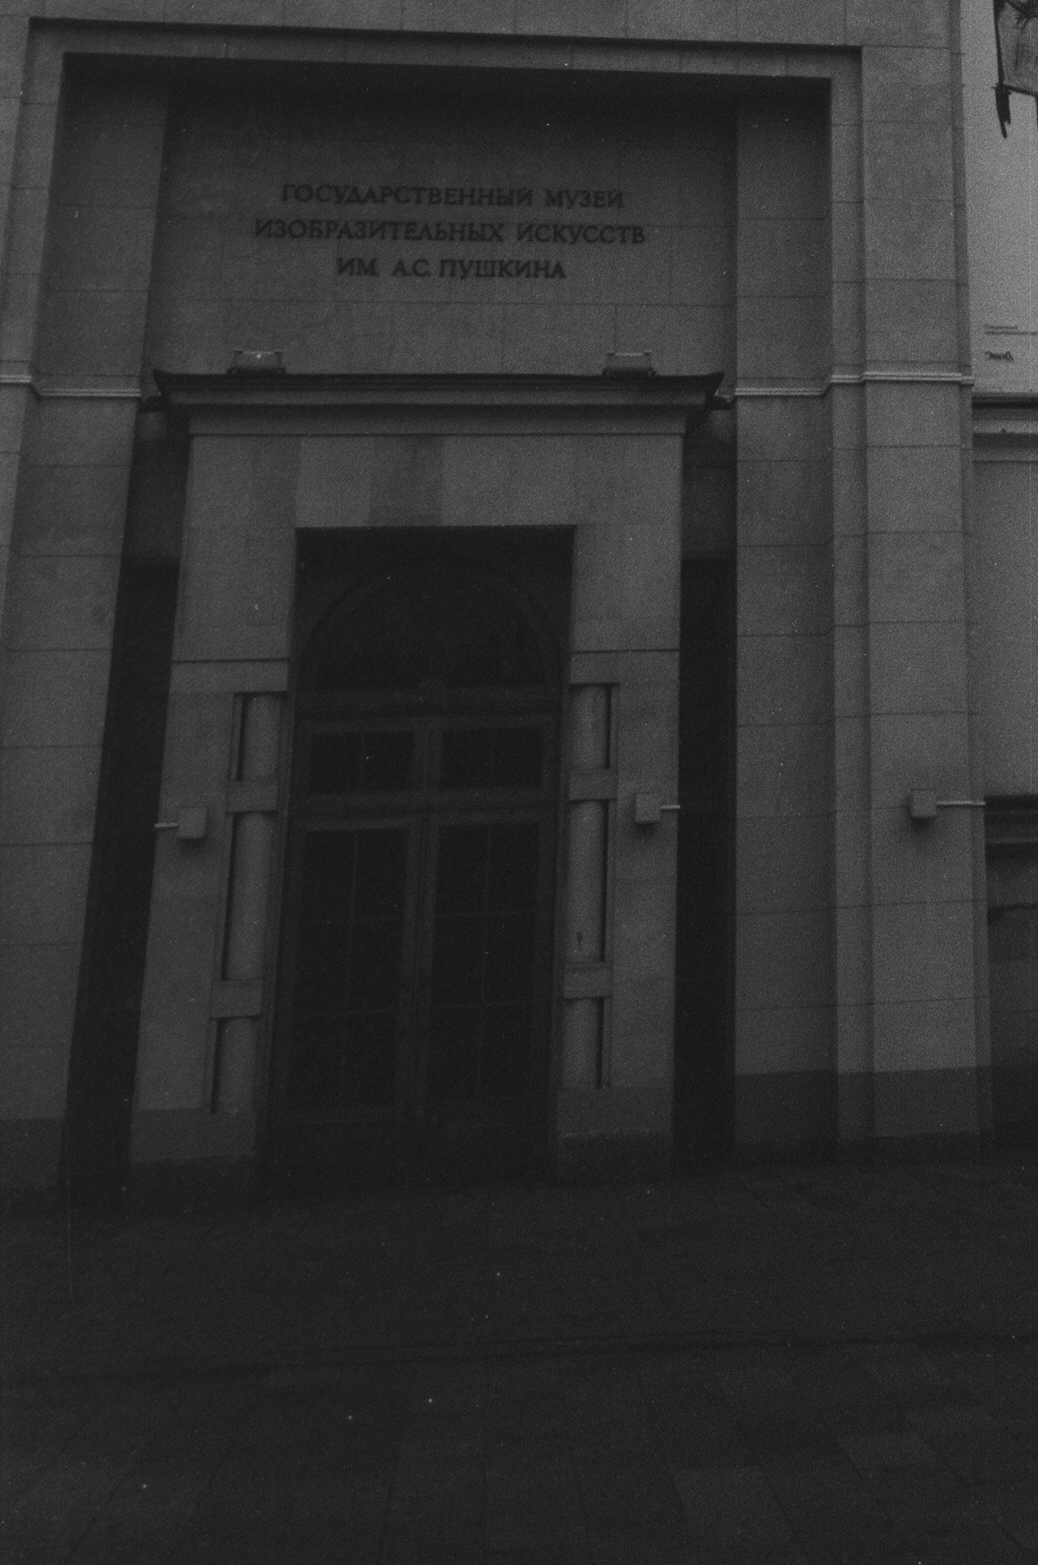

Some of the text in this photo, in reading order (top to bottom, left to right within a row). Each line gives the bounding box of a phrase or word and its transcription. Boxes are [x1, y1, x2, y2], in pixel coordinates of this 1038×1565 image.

[281, 183, 624, 210] ГОСУДАРСТВЕННЫЙ МУЗЕЙ
[254, 218, 647, 246] ИЗОБРАЗИТЕЛЬНЫХ ИСКУССТВ
[439, 258, 567, 281] ПУШКИНА
